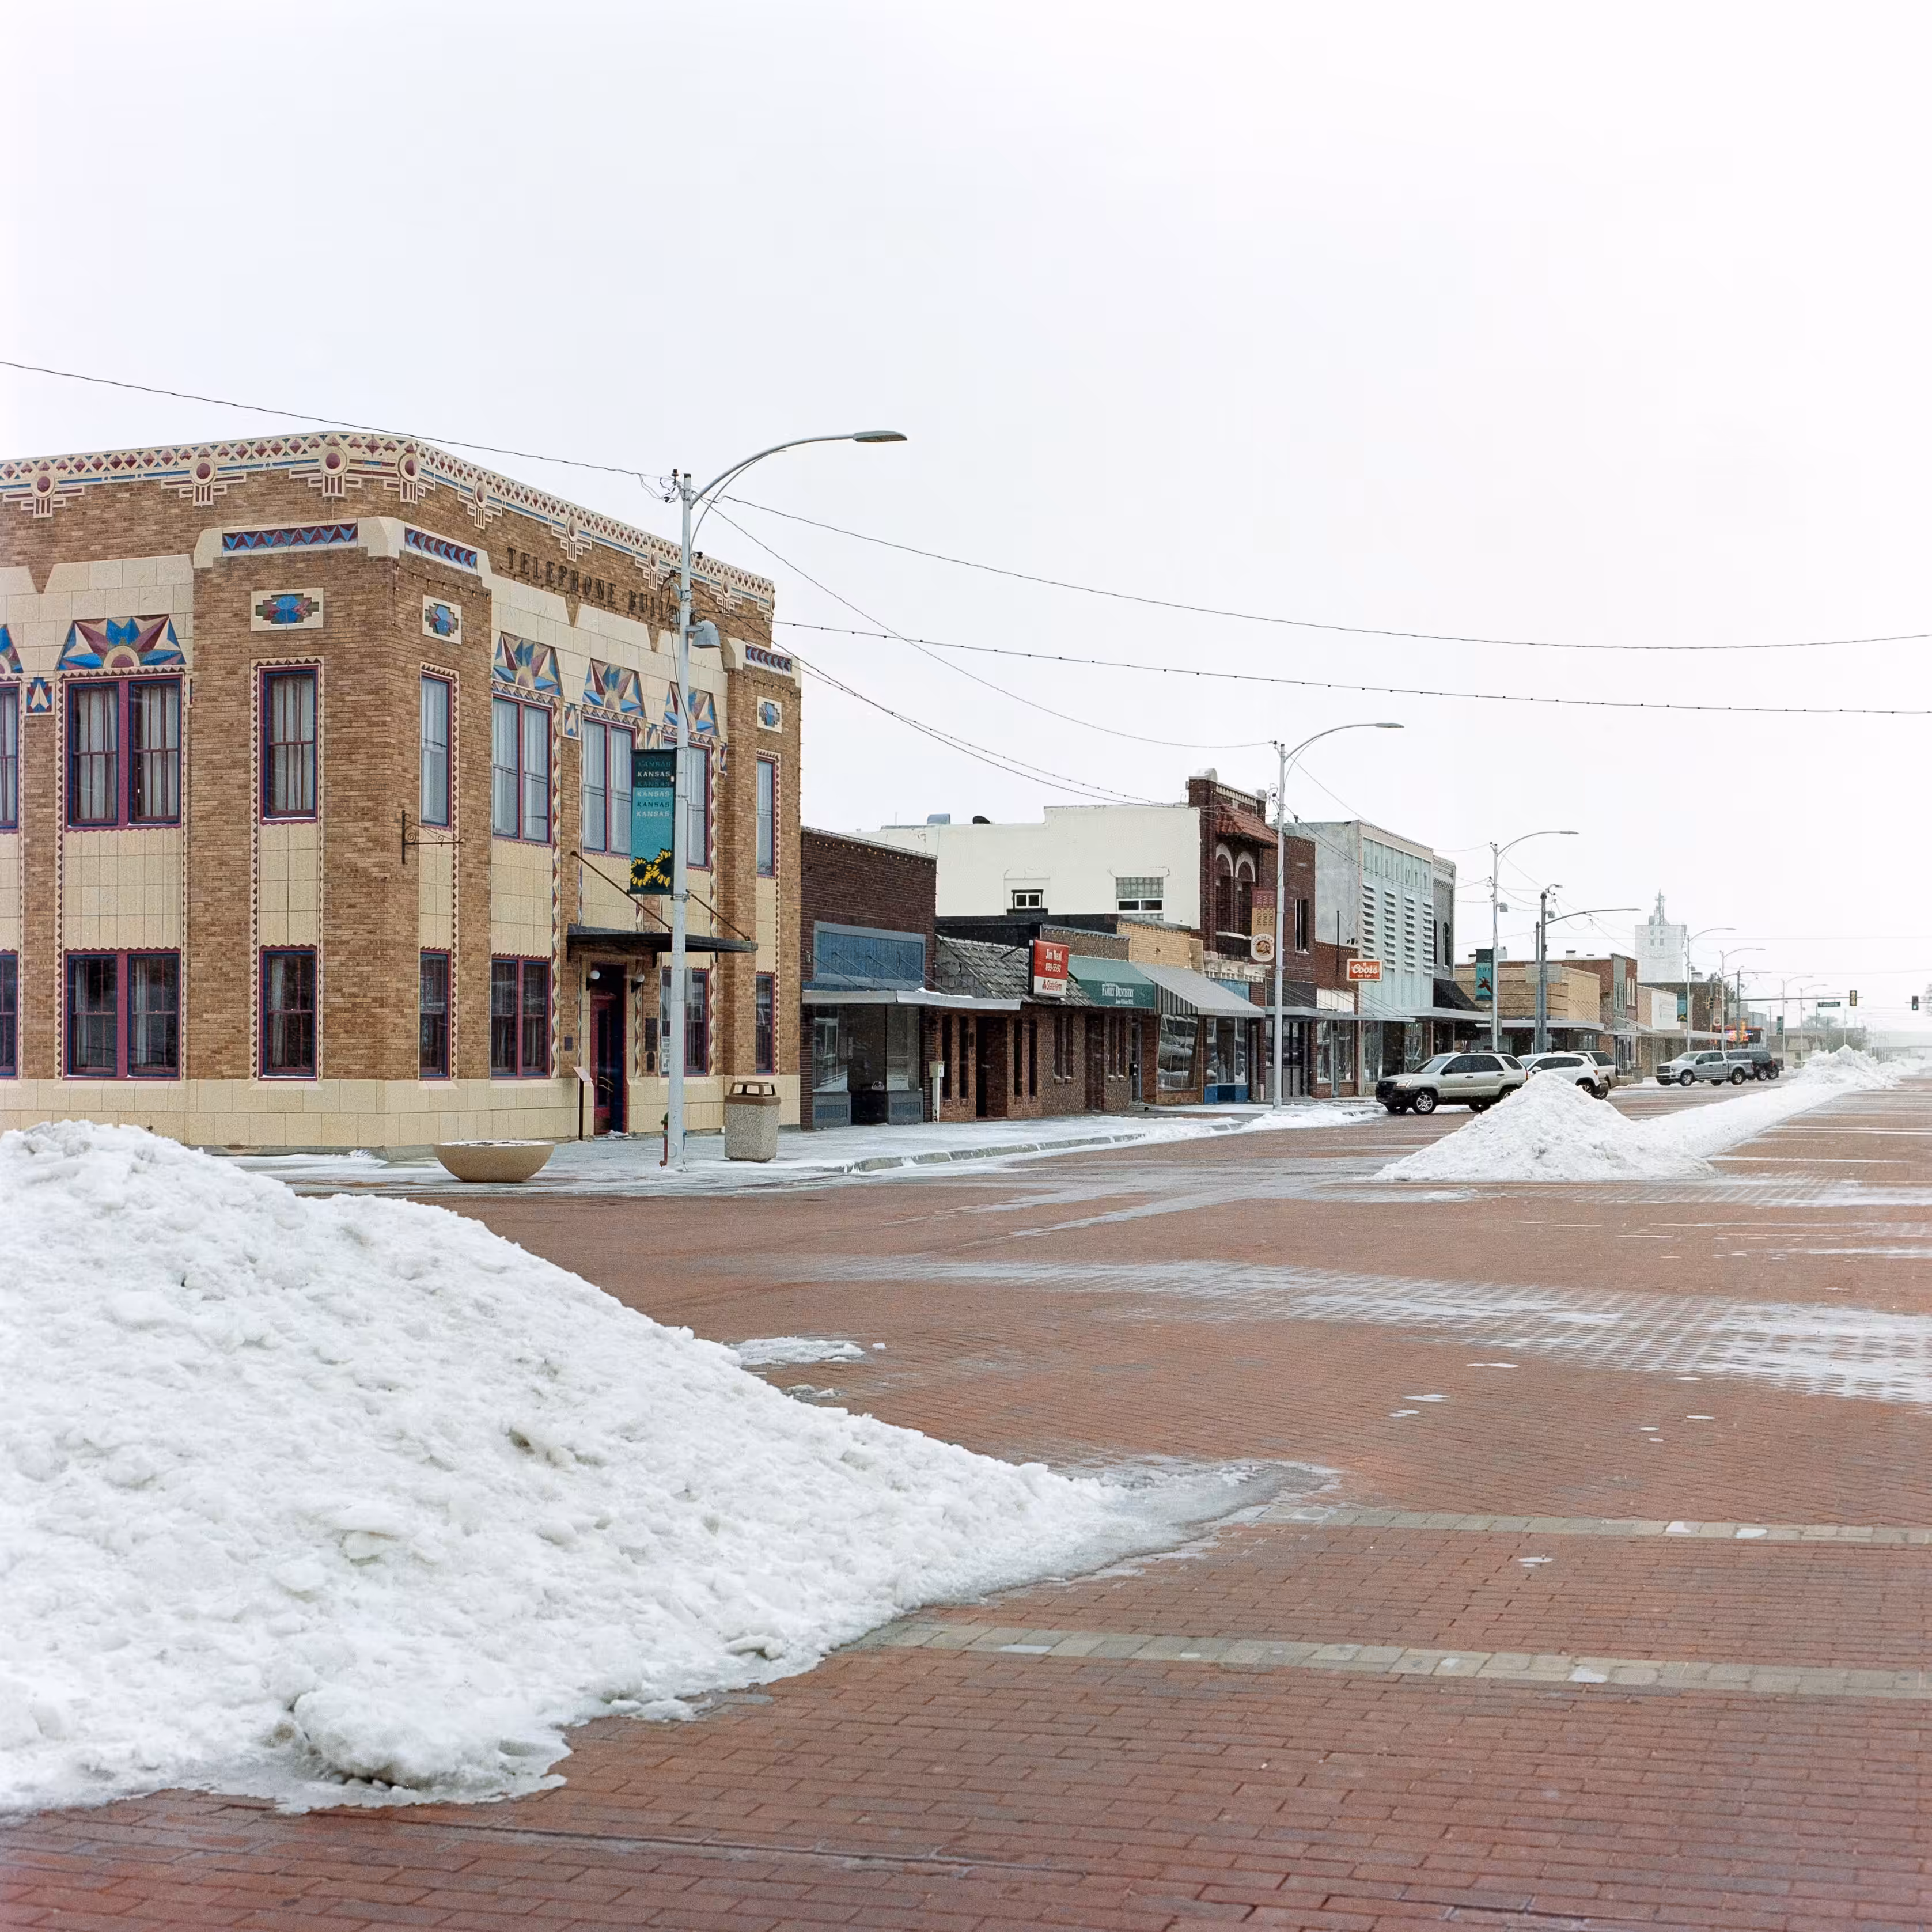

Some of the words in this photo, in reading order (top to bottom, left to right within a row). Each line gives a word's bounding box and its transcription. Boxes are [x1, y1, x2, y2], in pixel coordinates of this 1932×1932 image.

[506, 547, 616, 604] TELEPHONE
[1351, 964, 1378, 974] Coors
[1102, 984, 1115, 996] FAMILY
[1115, 985, 1134, 997] DENTISTRY
